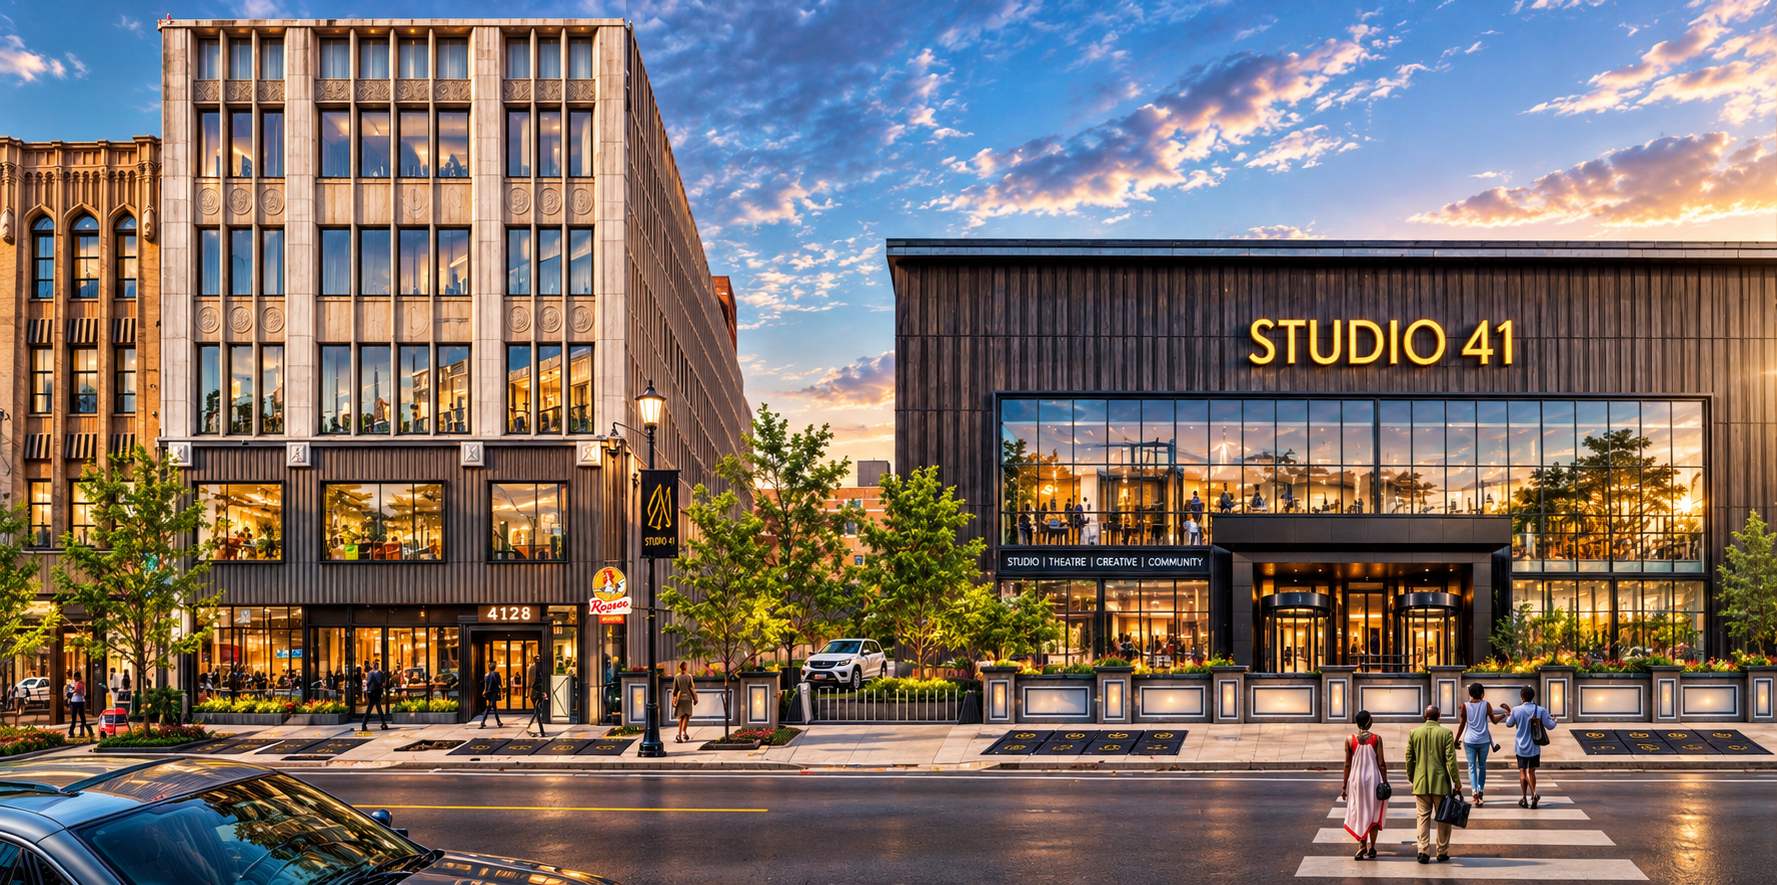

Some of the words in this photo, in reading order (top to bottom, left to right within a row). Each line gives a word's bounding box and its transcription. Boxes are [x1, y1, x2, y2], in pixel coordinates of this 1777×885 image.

[1248, 318, 1446, 366] STUDIO
[1461, 319, 1513, 365] 41
[644, 536, 667, 546] STUDIO
[668, 536, 675, 546] 41
[1007, 557, 1040, 567] STUDIO
[1048, 557, 1087, 567] THEATRE
[1096, 557, 1138, 567] CREATIVE
[1147, 557, 1204, 567] COMMUNITY
[486, 606, 531, 620] 4128
